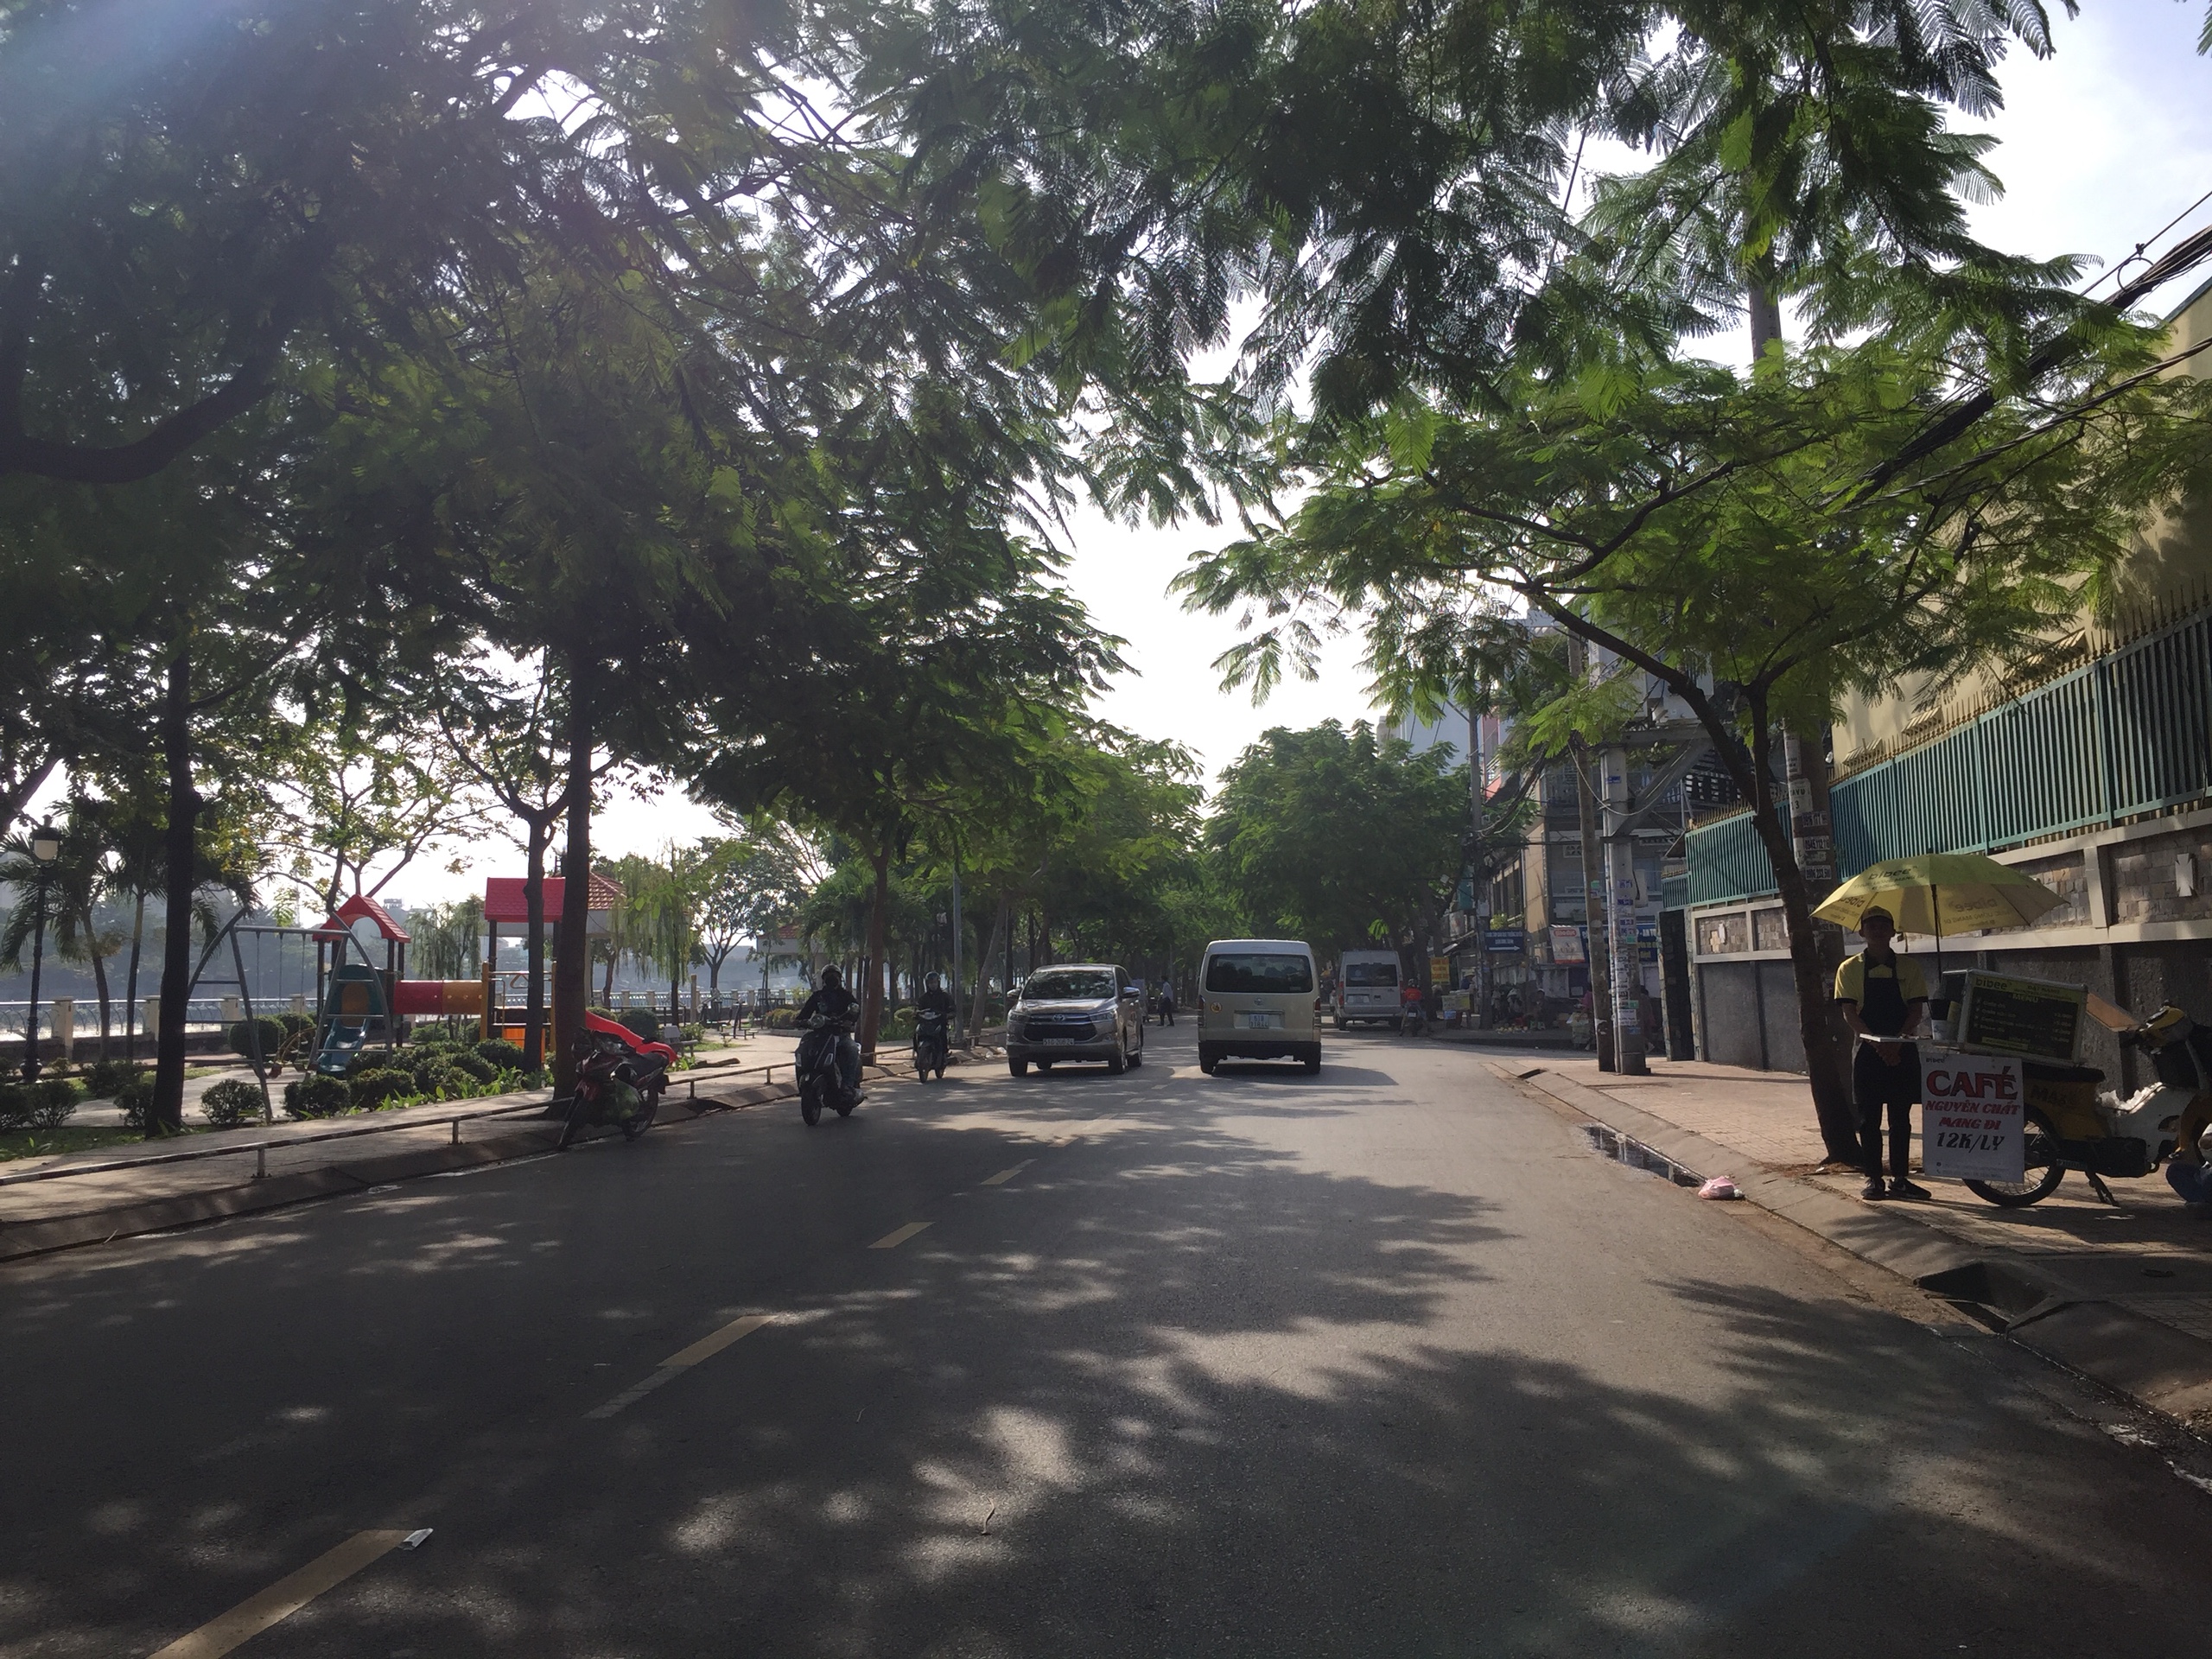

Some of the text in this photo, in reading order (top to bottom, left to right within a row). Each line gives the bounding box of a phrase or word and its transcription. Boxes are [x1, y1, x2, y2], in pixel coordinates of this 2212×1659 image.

[1868, 868, 1911, 880] bibee
[1975, 977, 2007, 990] bibee
[1926, 1065, 2018, 1100] CAFÉ
[1925, 1099, 2020, 1115] NGUYÊN CHẤT
[1938, 1116, 2001, 1130] MANG ĐI
[1936, 1132, 2005, 1154] 12K/LY
